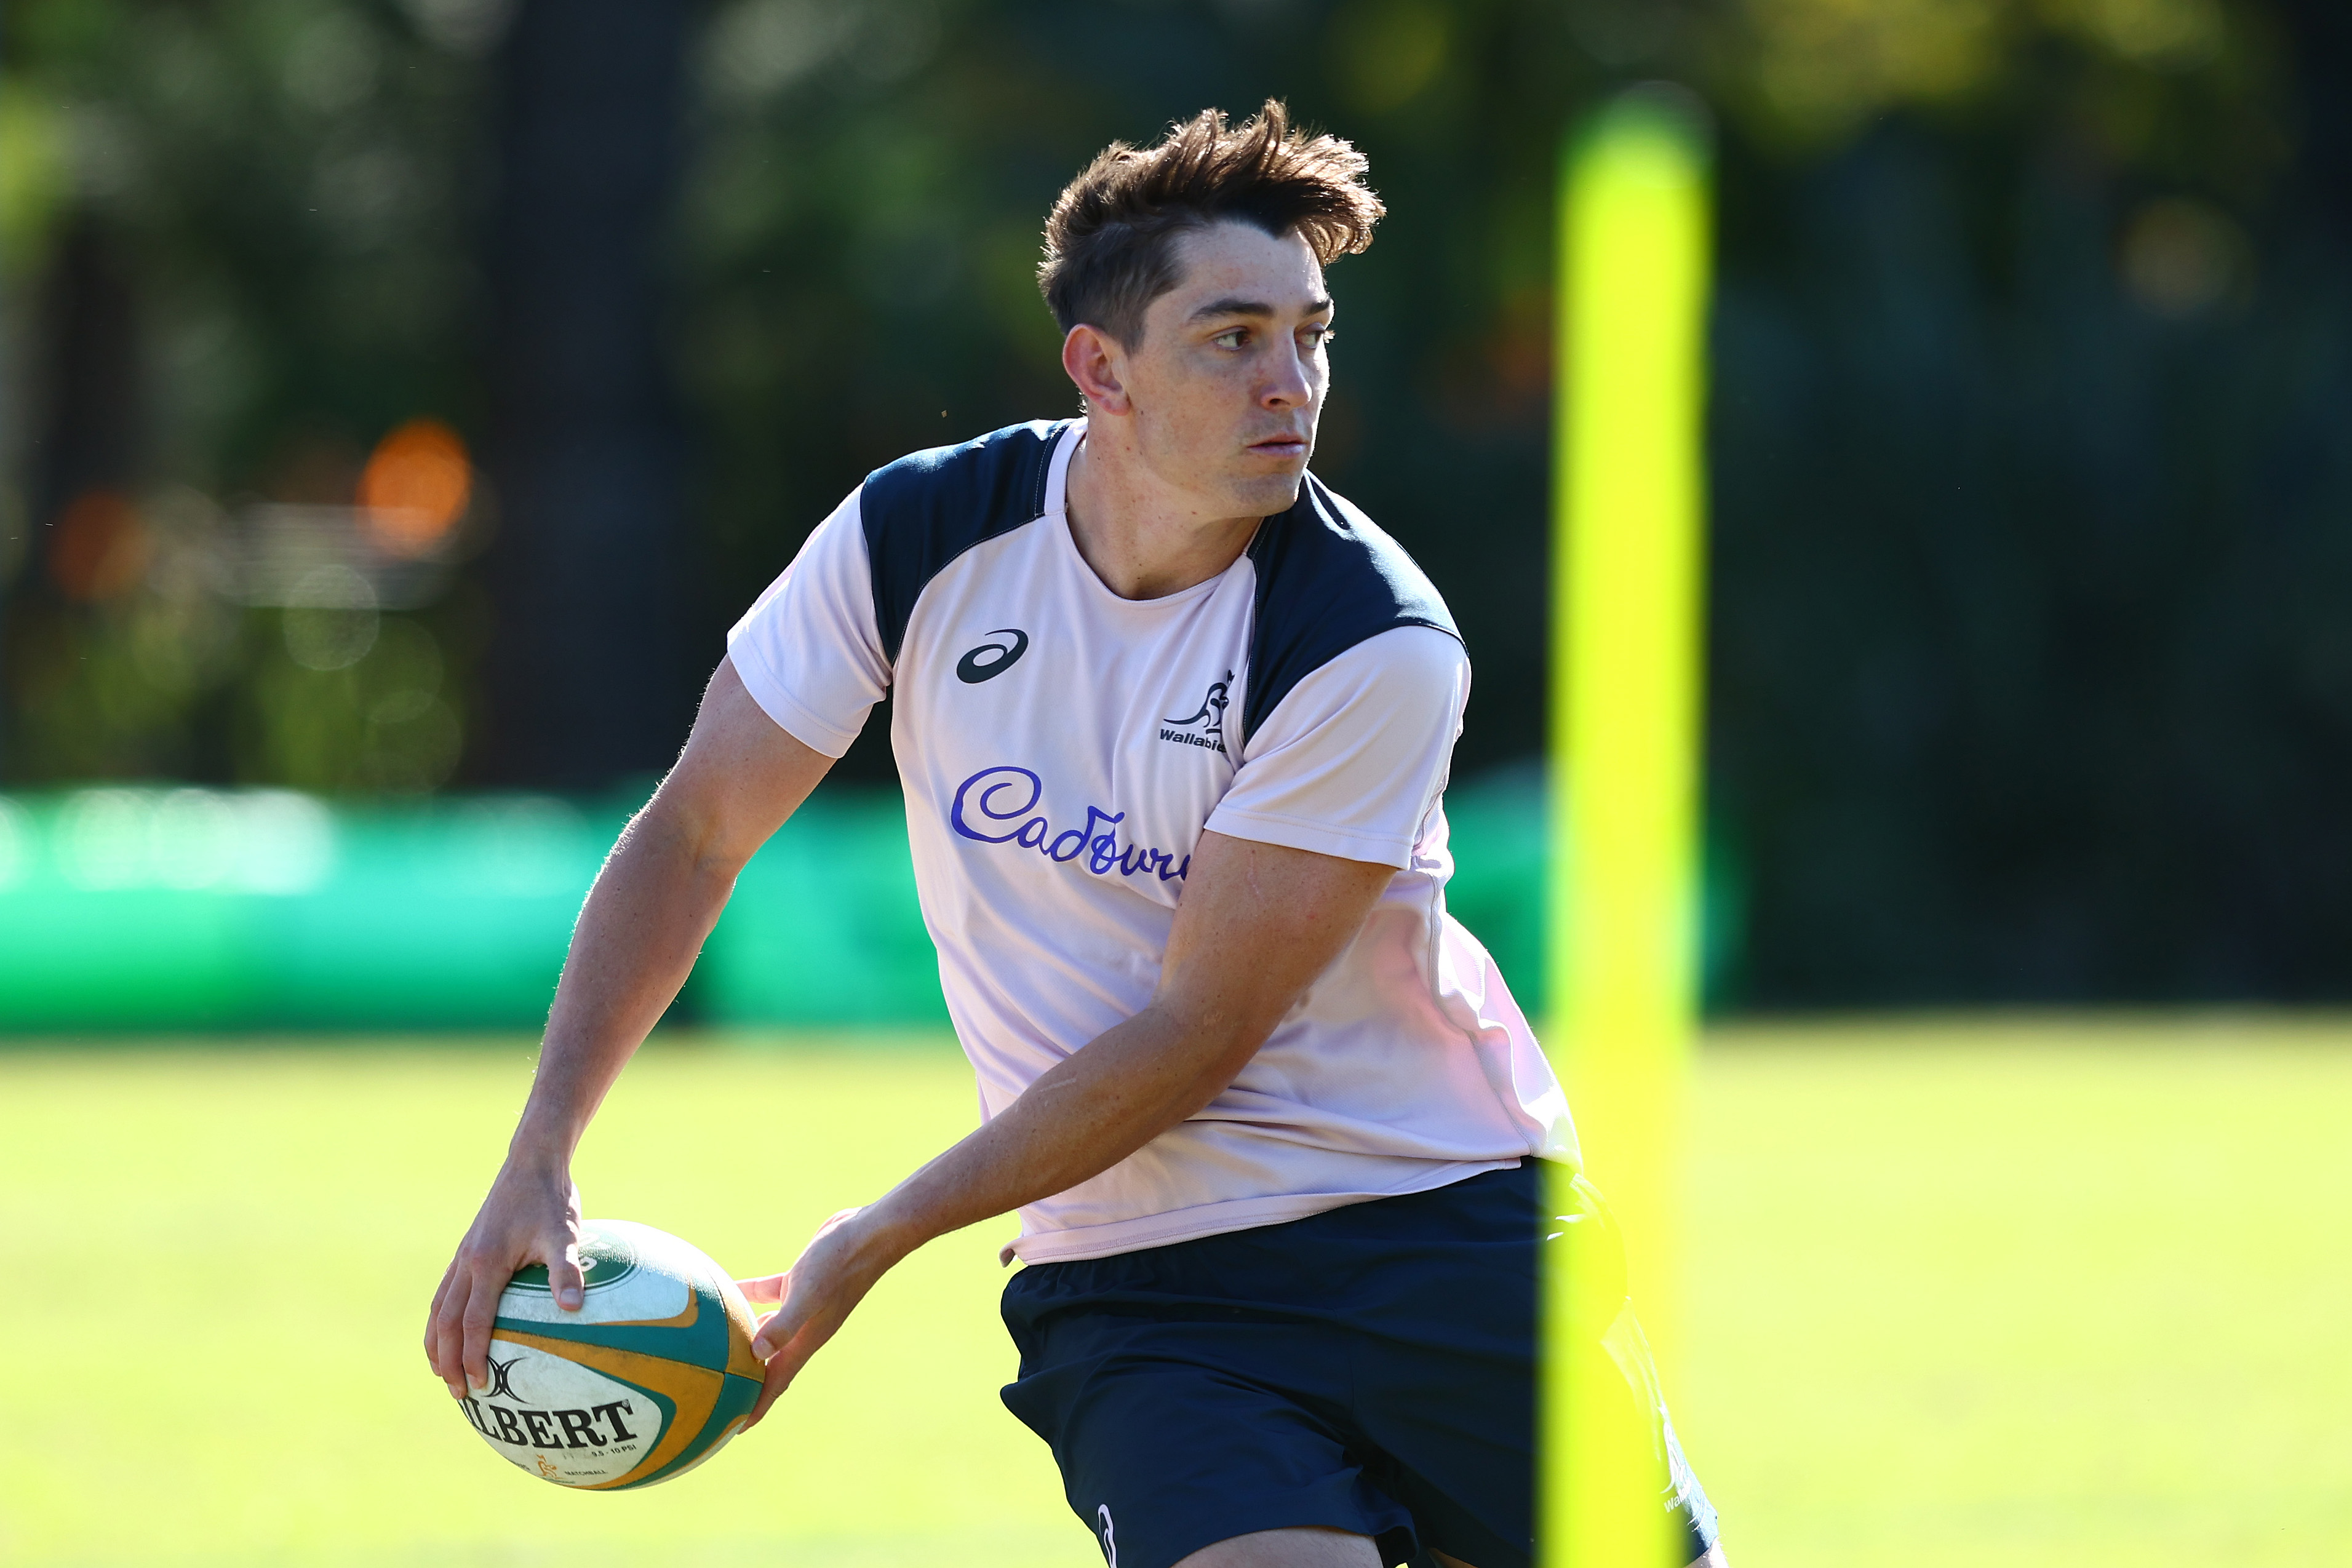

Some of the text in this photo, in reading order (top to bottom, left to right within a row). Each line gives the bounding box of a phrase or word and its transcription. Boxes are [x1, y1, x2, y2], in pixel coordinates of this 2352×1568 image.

[458, 1395, 638, 1449] ILBERT
[621, 1444, 637, 1452] PSI
[1664, 1477, 1692, 1513] Walla
